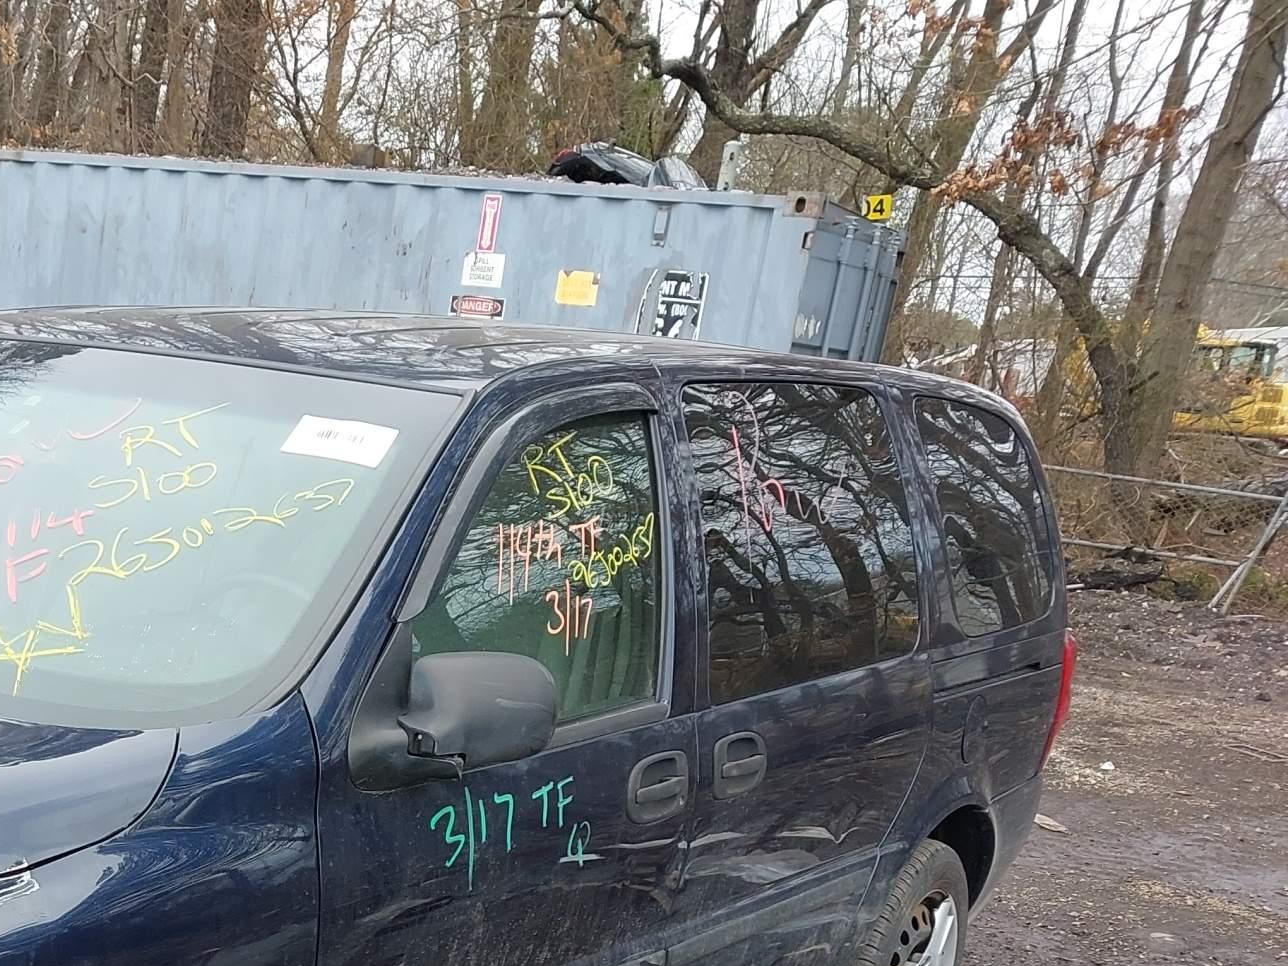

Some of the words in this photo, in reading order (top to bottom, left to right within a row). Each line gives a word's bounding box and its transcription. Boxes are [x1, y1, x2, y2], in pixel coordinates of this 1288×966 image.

[521, 431, 578, 495] RT
[546, 579, 593, 656] 3/17
[430, 786, 514, 891] 3/17
[532, 776, 575, 828] TF
